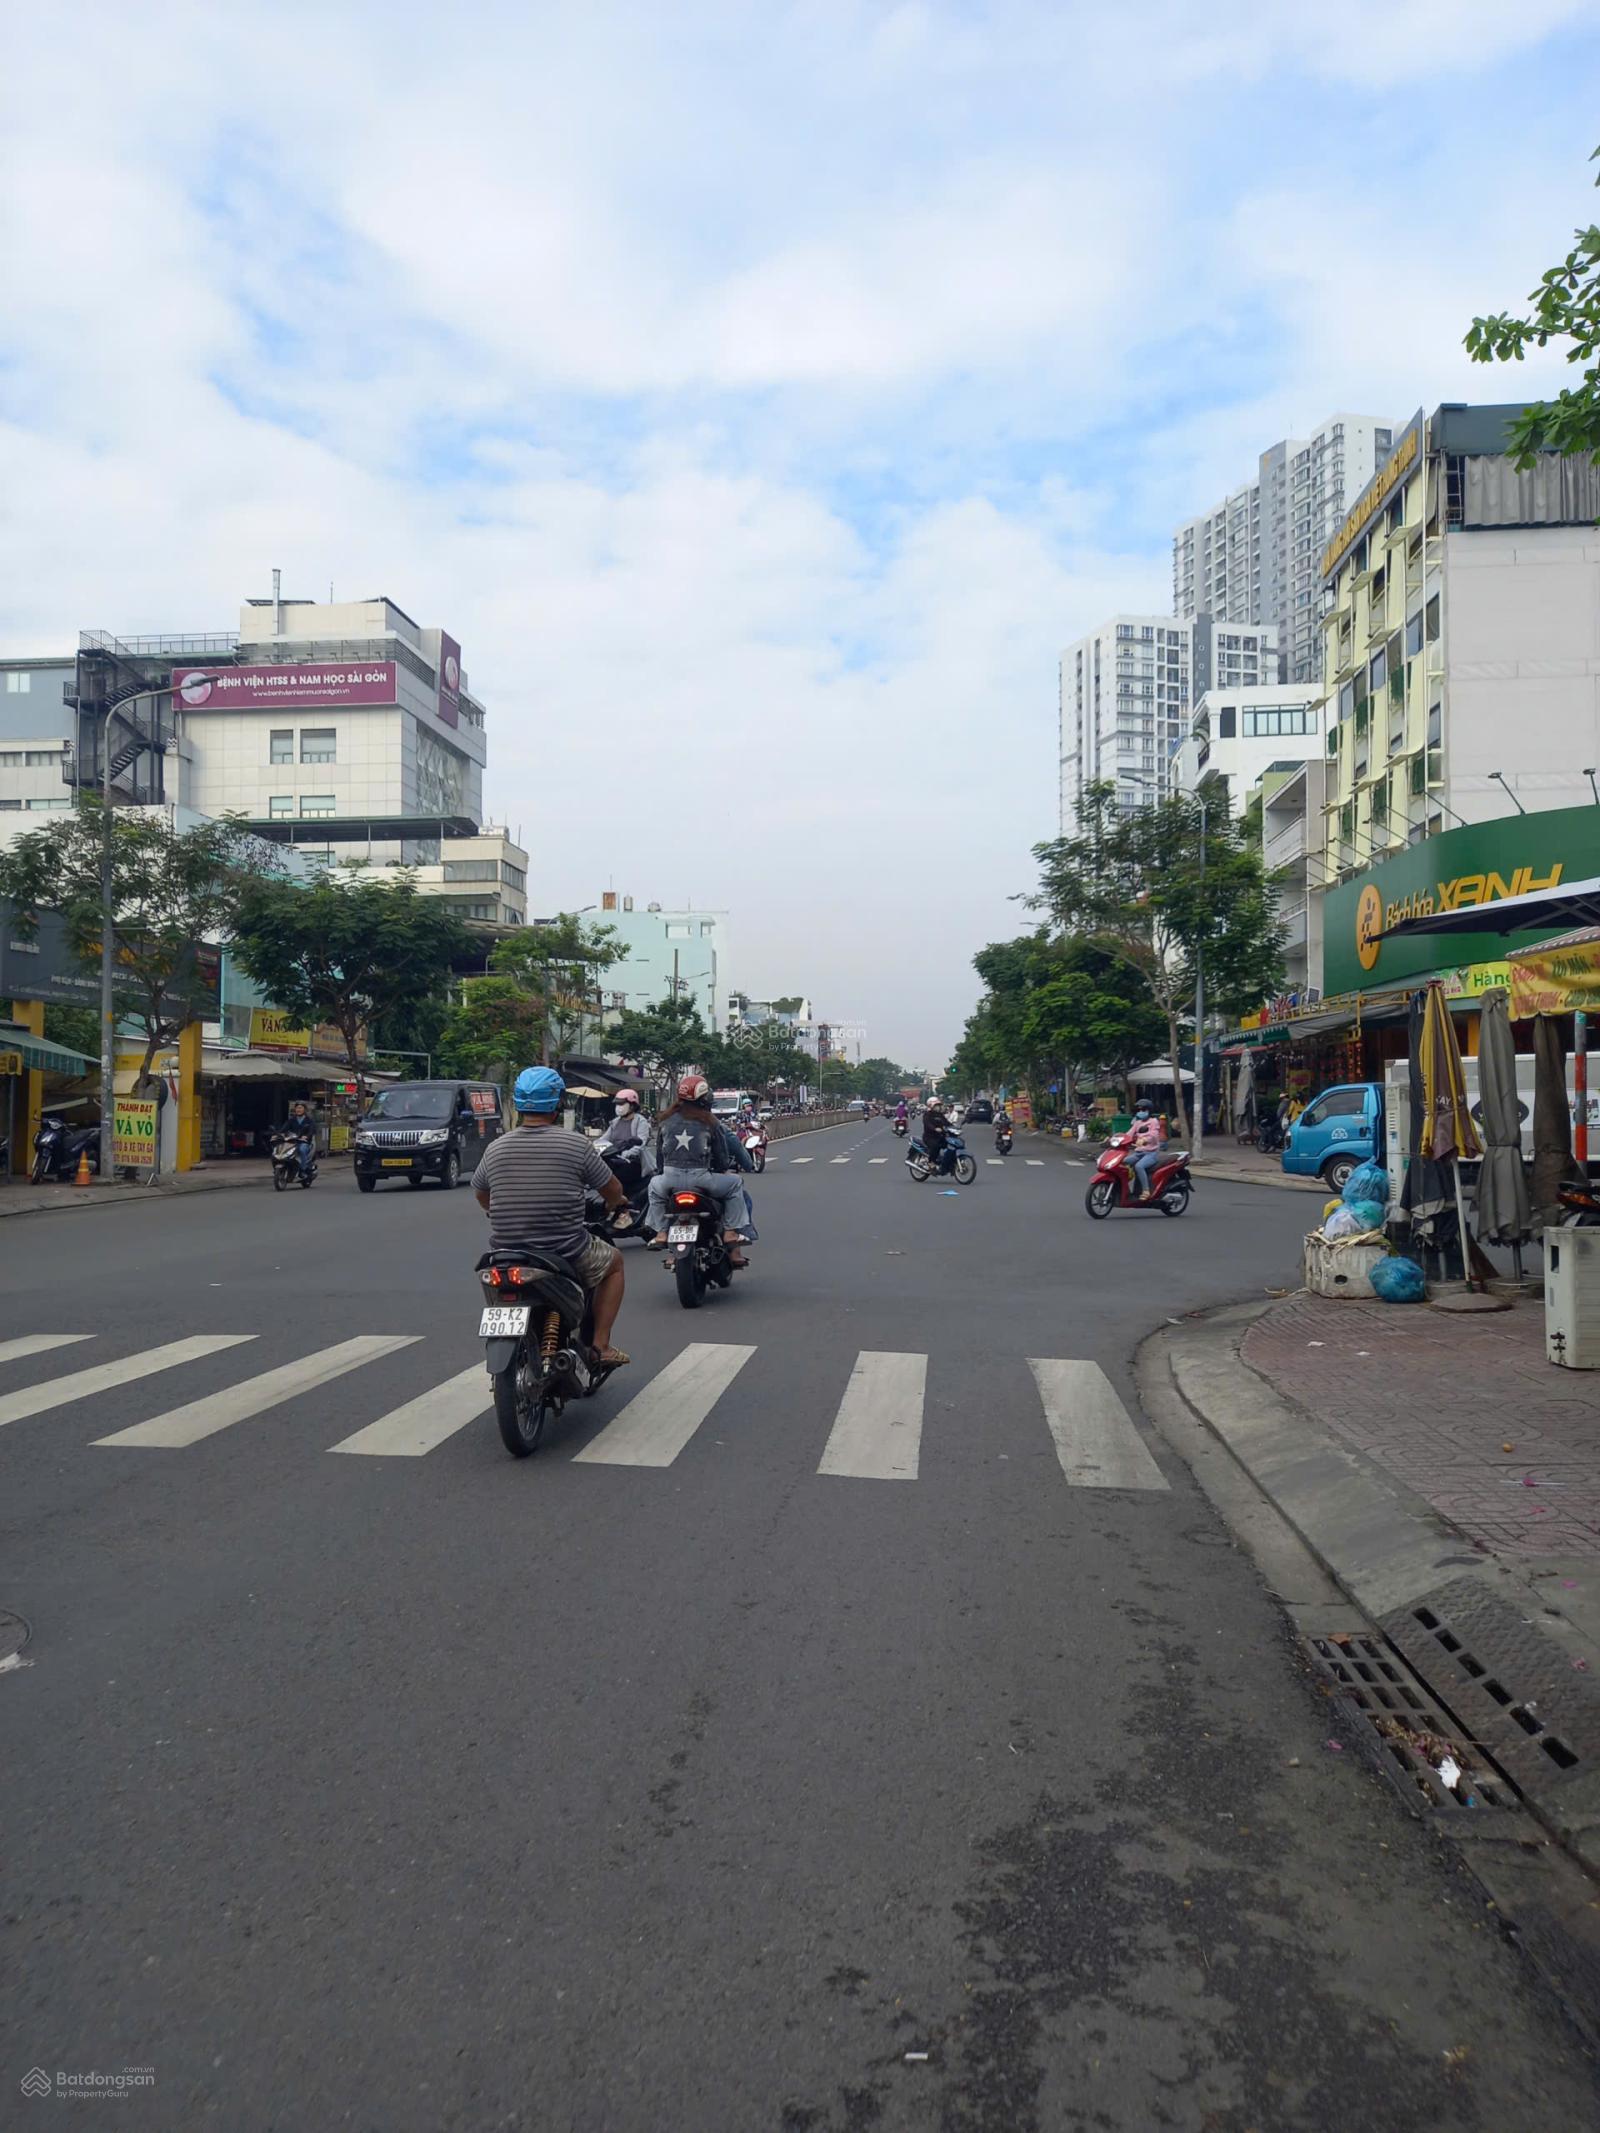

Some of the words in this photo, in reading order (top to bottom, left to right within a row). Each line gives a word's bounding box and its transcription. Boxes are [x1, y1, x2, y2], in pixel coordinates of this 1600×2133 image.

[217, 675, 241, 690] BỆNH
[243, 674, 265, 689] VIỆN
[266, 675, 288, 686] HTSS
[290, 675, 297, 685] &
[300, 674, 321, 684] NAM
[323, 674, 345, 686] HỌC
[347, 670, 362, 683] SÀI
[364, 669, 387, 682] GÒN
[1413, 888, 1434, 918] hóa
[1434, 864, 1563, 912] XANH
[116, 1114, 133, 1135] VÁ
[136, 1115, 153, 1136] VỎ
[488, 1308, 523, 1321] 59-K2
[480, 1321, 525, 1335] 090.12
